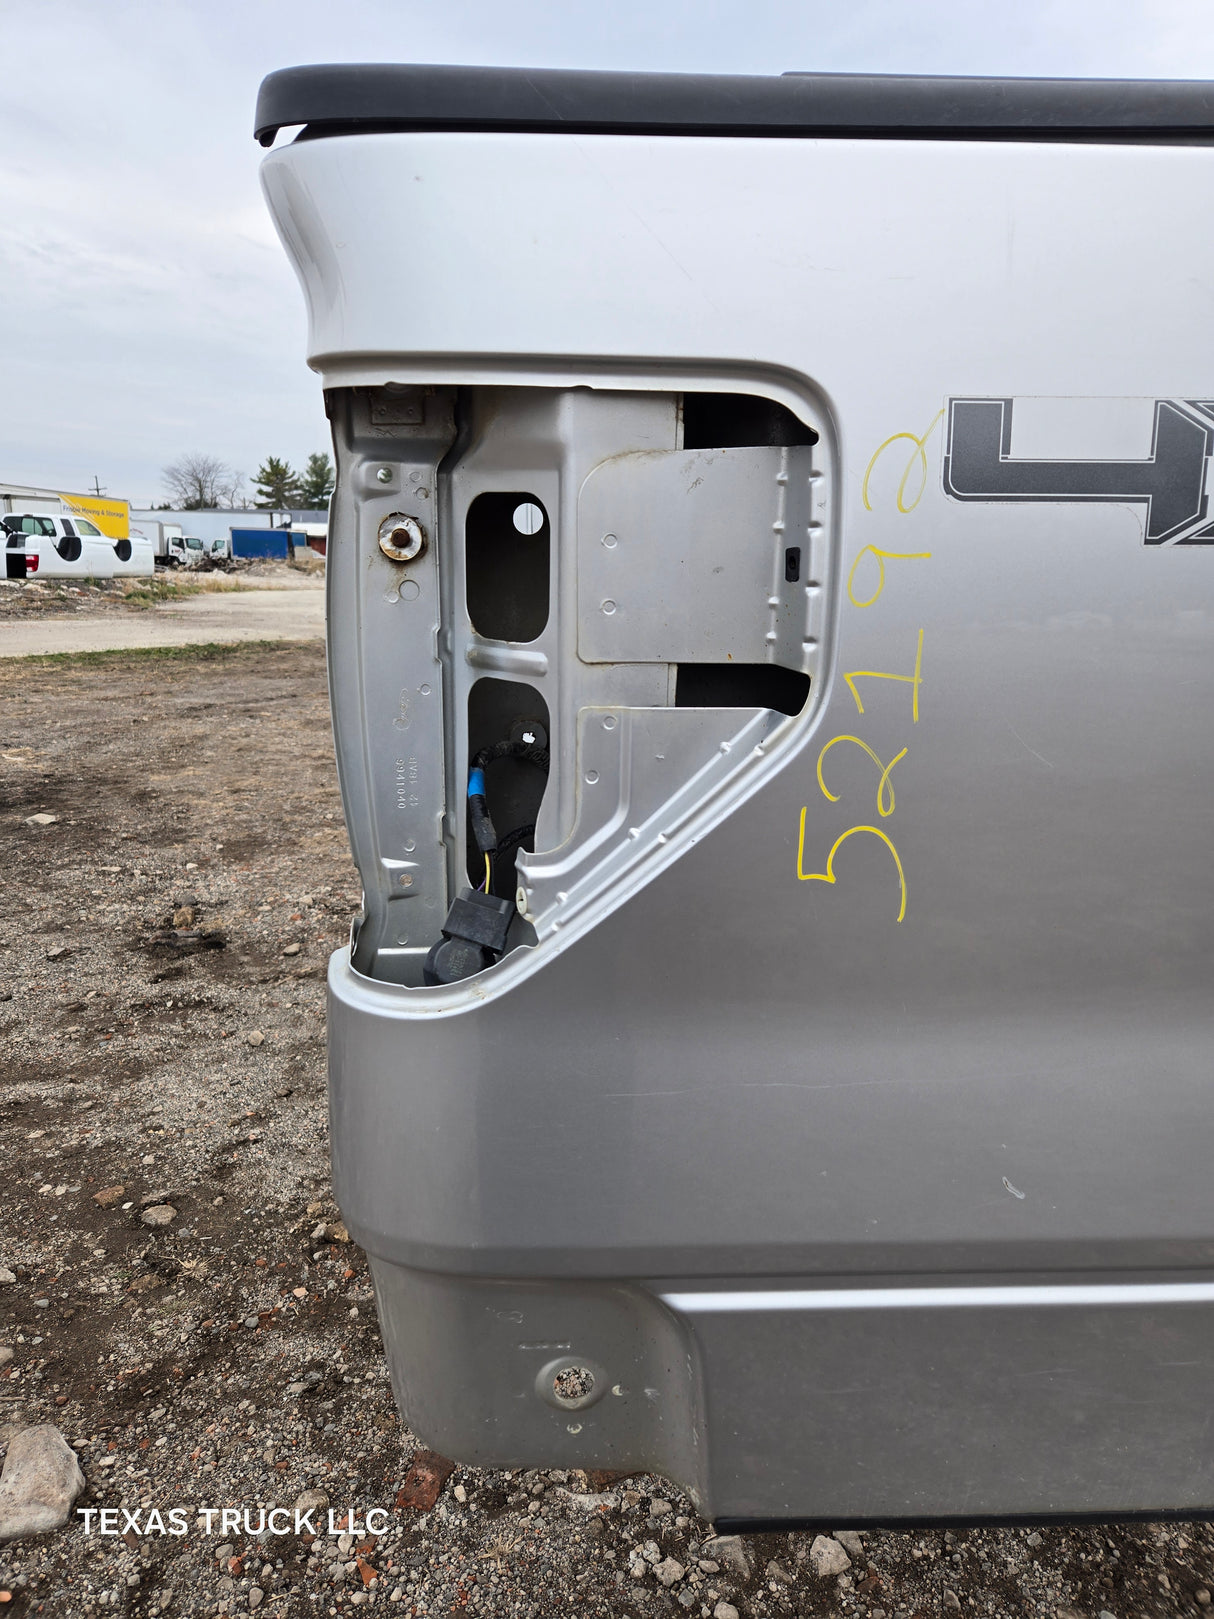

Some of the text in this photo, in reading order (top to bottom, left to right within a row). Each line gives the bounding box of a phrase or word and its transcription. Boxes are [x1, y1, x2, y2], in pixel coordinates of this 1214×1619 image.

[82, 507, 100, 516] Moving
[106, 510, 124, 518] Storage
[797, 408, 945, 922] 52192
